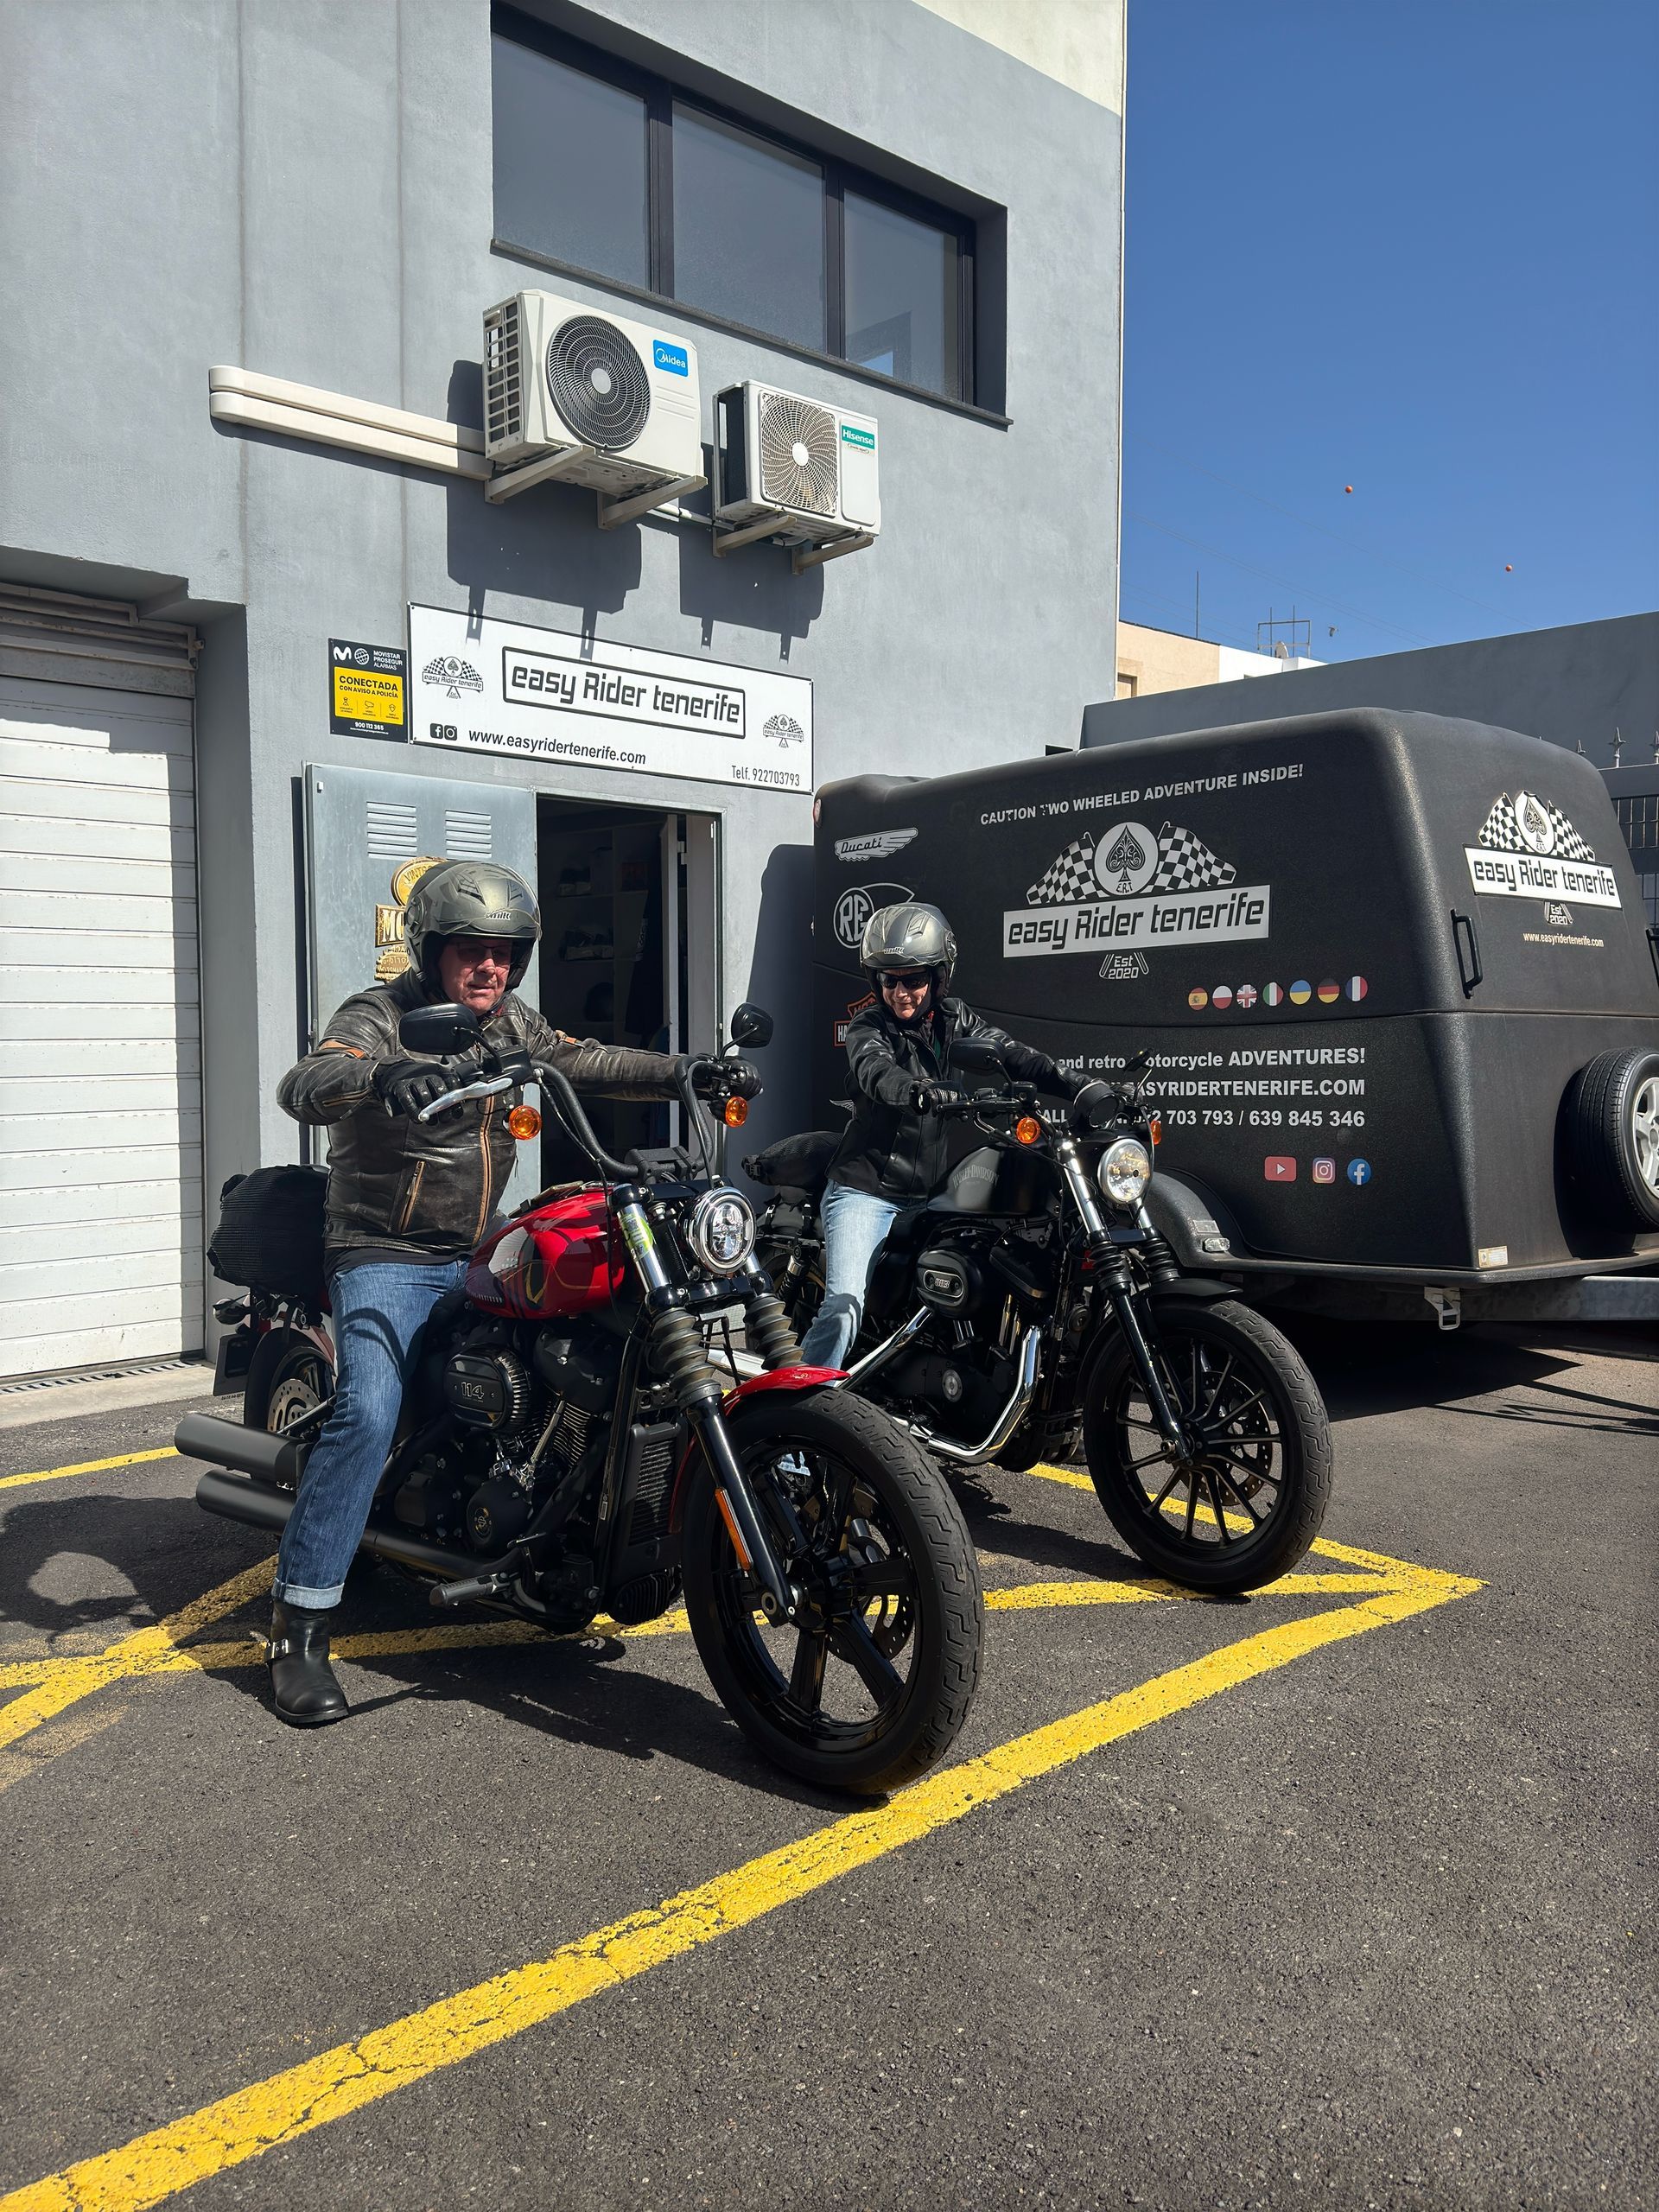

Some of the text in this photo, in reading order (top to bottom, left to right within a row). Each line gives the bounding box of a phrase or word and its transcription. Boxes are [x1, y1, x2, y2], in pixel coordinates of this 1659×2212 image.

[655, 347, 686, 368] Midea
[842, 429, 874, 446] Hisense
[373, 650, 401, 659] MOVISTAR
[373, 657, 403, 665] PROSEGUR
[339, 676, 398, 691] CONECTADA
[458, 680, 482, 689] tenerife
[512, 665, 740, 723] easy Rider tenerife
[468, 730, 646, 765] www.easyridertenerife.com
[731, 765, 800, 786] Telf. 922703793
[980, 806, 1036, 825] CAUTION
[1073, 790, 1140, 811] WHEELED
[1143, 774, 1237, 801] ADVENTURE
[1243, 764, 1304, 785] INSIDE!
[841, 837, 882, 854] Ducati
[1473, 859, 1615, 896] easy Rider tenerife
[1550, 905, 1563, 915] Est
[1008, 892, 1265, 950] easy Rider tenerife
[1549, 915, 1568, 925] 2020
[1522, 932, 1605, 947] www.easyridertenerife.com
[1114, 956, 1134, 968] Est
[1108, 967, 1139, 979] 2020
[1089, 1054, 1126, 1069] retro
[1145, 1052, 1224, 1071] otorcycle
[1228, 1047, 1365, 1066] ADVENTURES!
[1166, 1110, 1197, 1125] 703
[1202, 1110, 1234, 1125] 793
[1238, 1109, 1244, 1126] /
[1249, 1110, 1282, 1126] 639
[1288, 1110, 1323, 1127] 845
[1329, 1110, 1365, 1127] 346
[461, 1382, 485, 1399] 114
